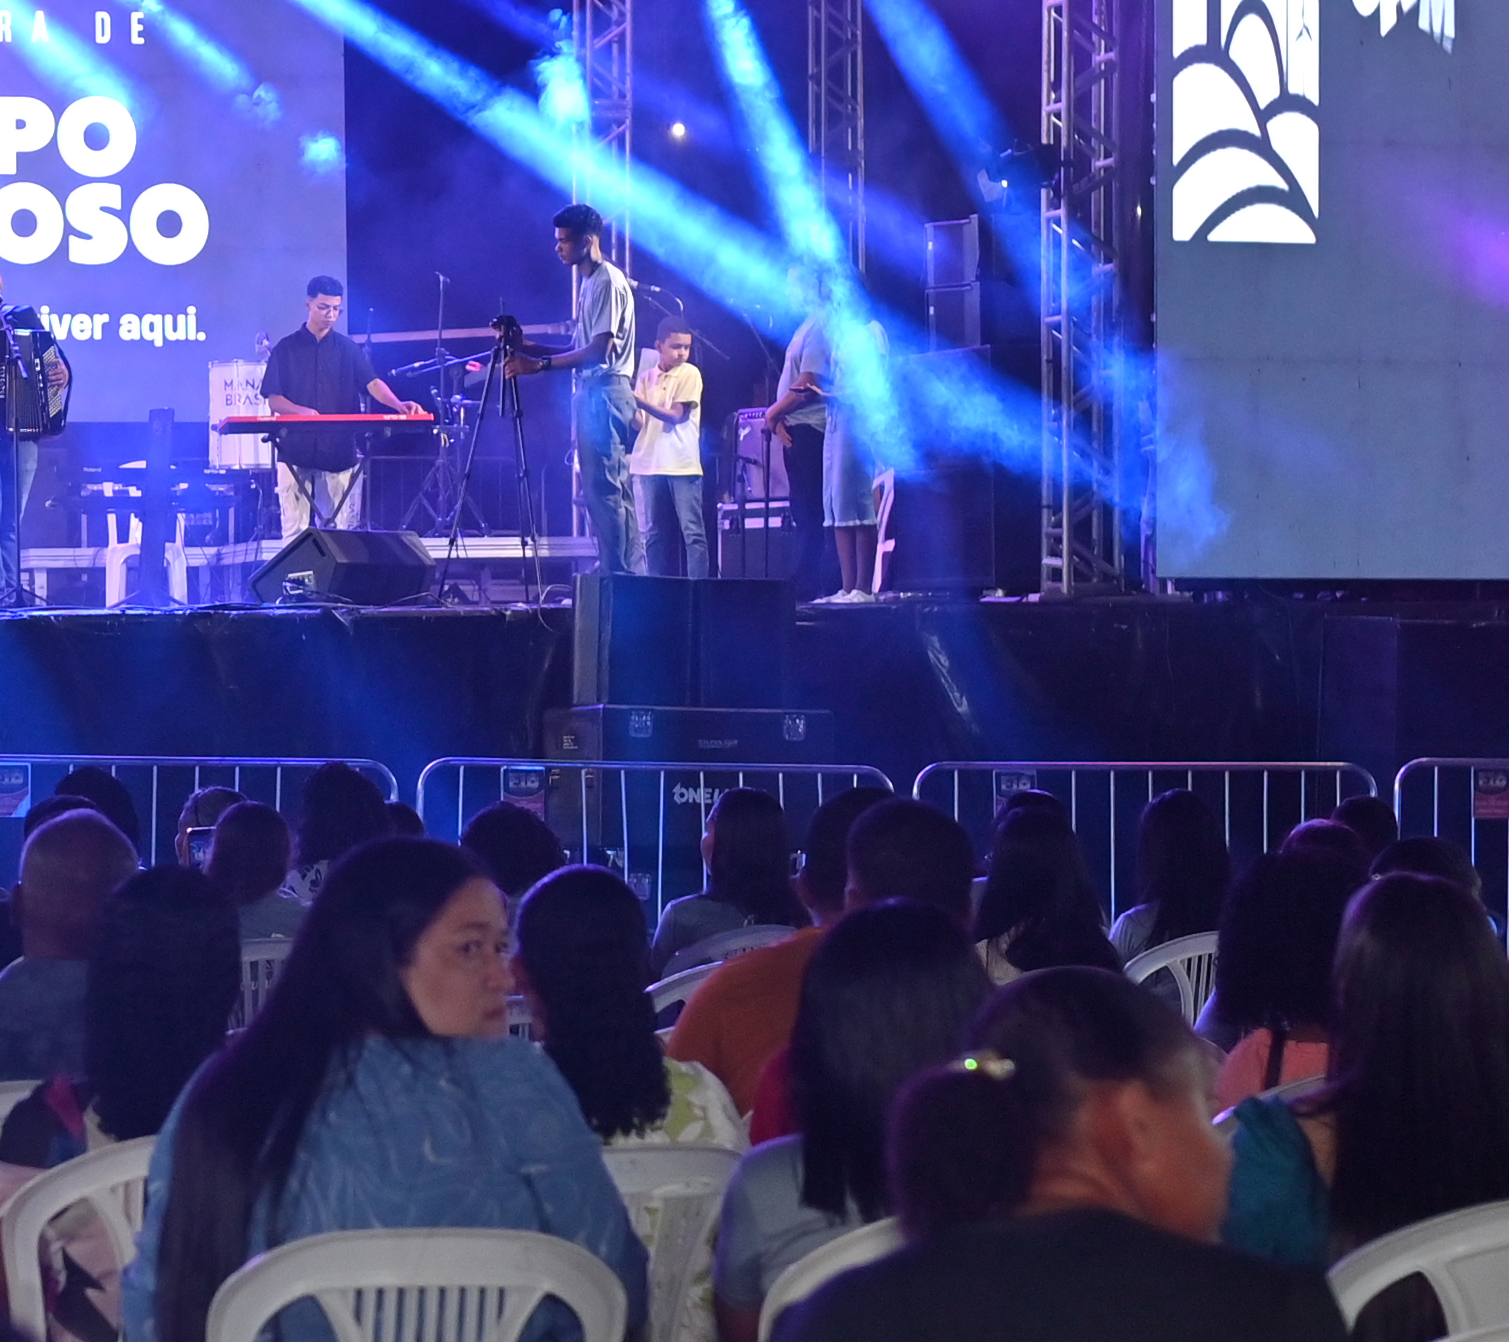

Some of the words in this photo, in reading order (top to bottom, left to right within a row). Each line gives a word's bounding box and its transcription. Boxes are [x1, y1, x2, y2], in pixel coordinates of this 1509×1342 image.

[94, 10, 146, 45] DE
[39, 305, 110, 341] iver
[119, 305, 207, 347] aqui.
